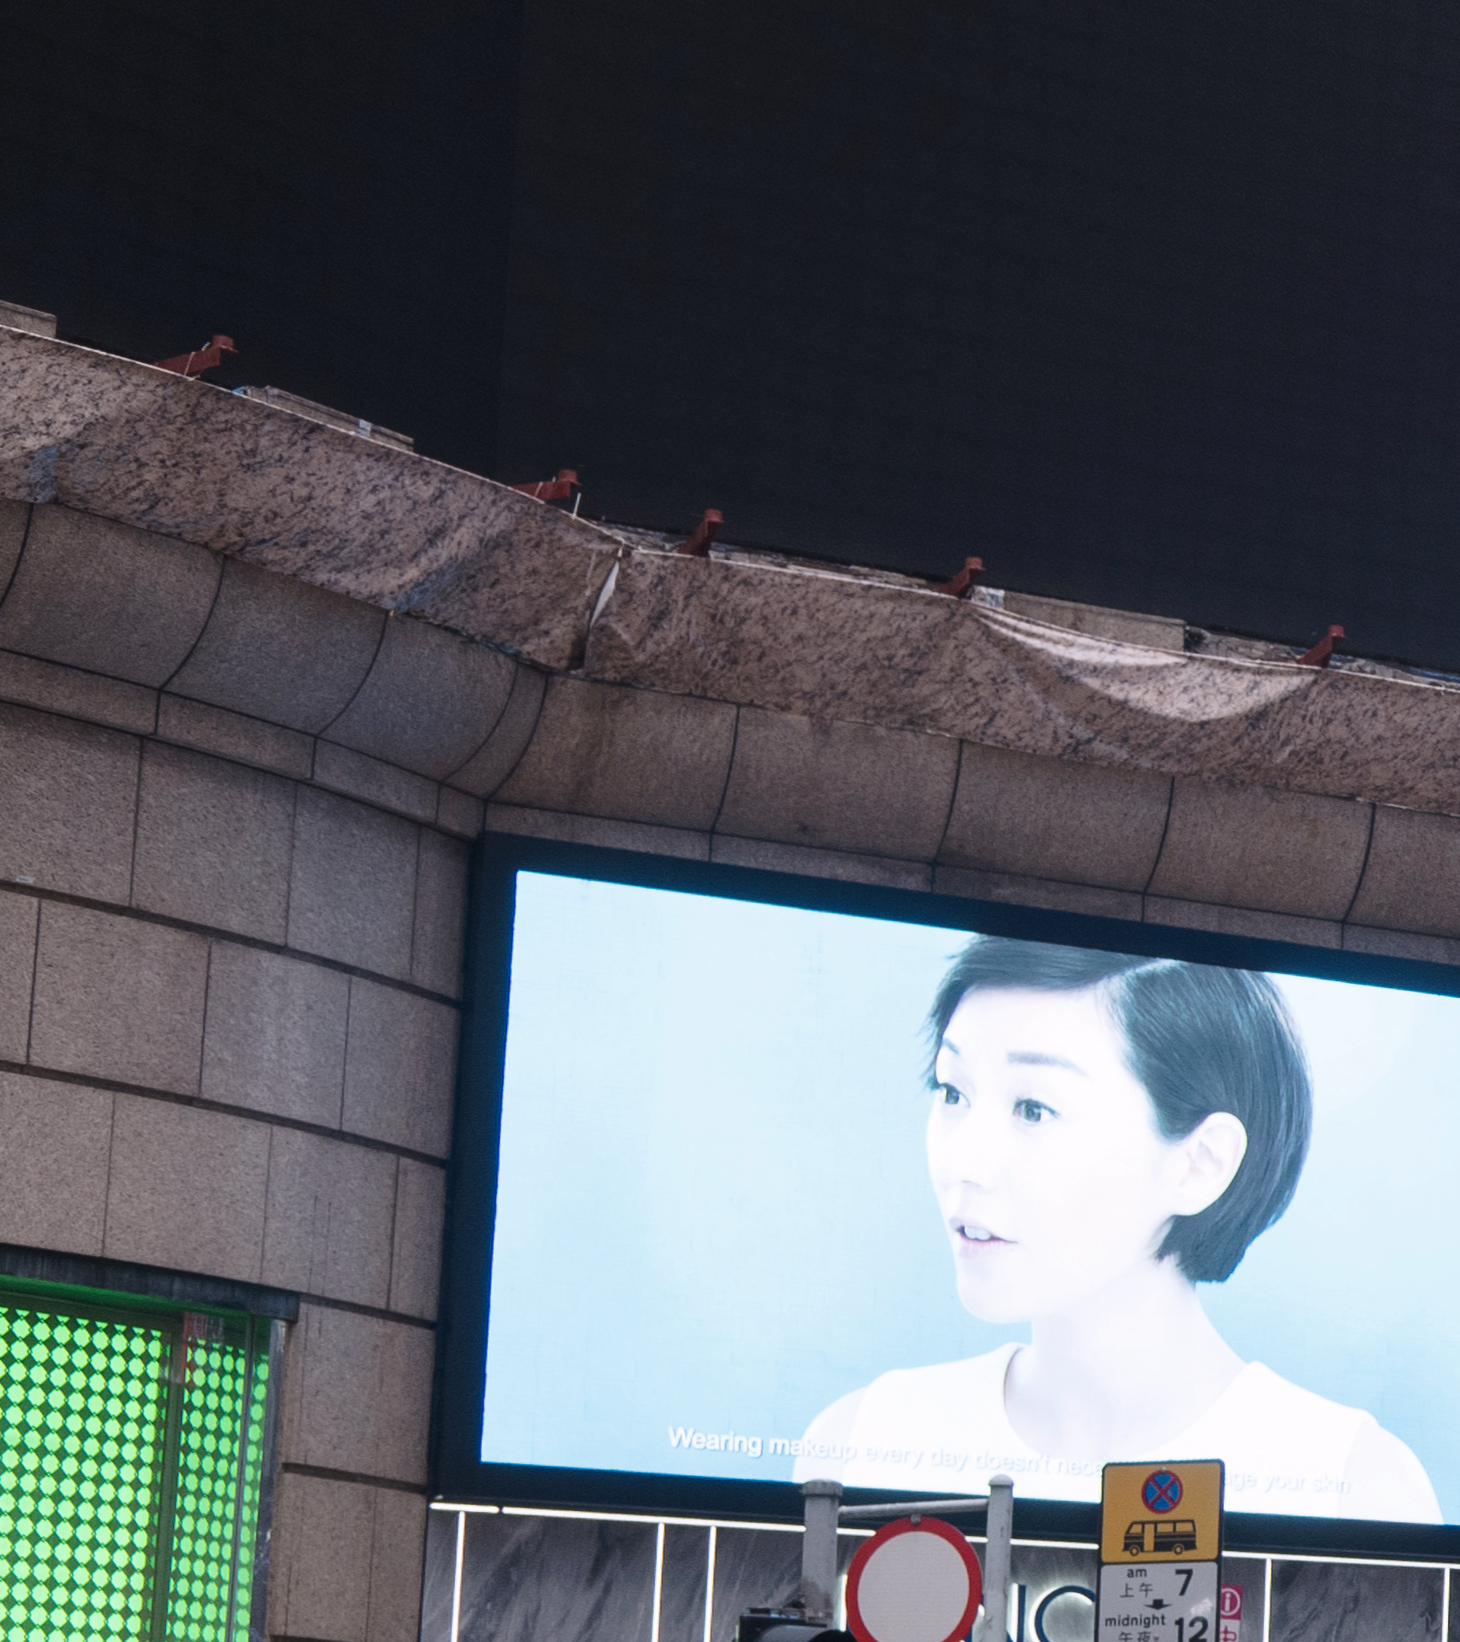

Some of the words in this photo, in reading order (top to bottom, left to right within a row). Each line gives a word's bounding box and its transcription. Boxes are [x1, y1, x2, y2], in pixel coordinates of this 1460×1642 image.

[668, 1426, 763, 1460] Wearing
[768, 1436, 858, 1465] makeup
[865, 1446, 925, 1469] every
[930, 1447, 971, 1472] day
[1126, 1567, 1149, 1579] am
[1119, 1582, 1155, 1598] 上午
[1173, 1568, 1195, 1597] 7
[1104, 1613, 1167, 1631] midnight
